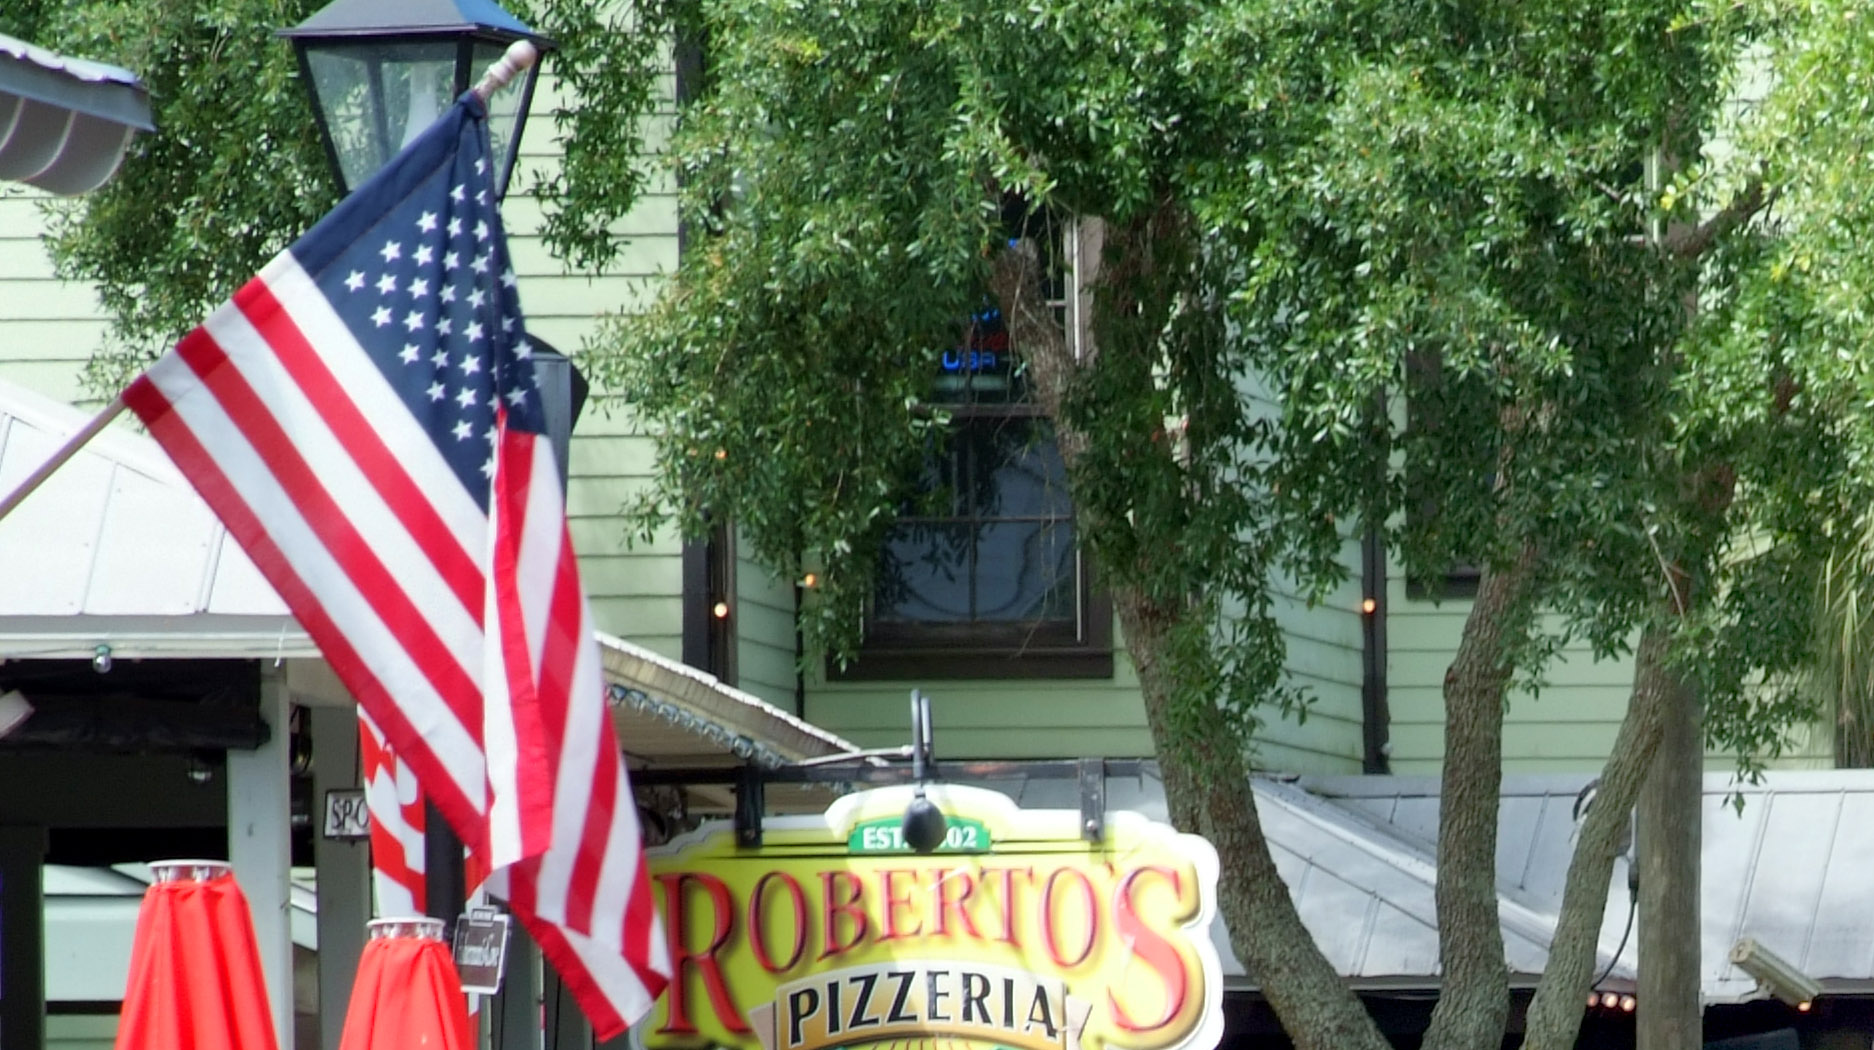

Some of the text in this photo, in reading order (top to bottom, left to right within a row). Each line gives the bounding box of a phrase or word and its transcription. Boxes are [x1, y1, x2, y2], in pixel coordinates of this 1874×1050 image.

[332, 799, 369, 829] SPO
[653, 862, 1191, 1036] ROBERTO'S
[789, 970, 1058, 1045] PIZZERIA
